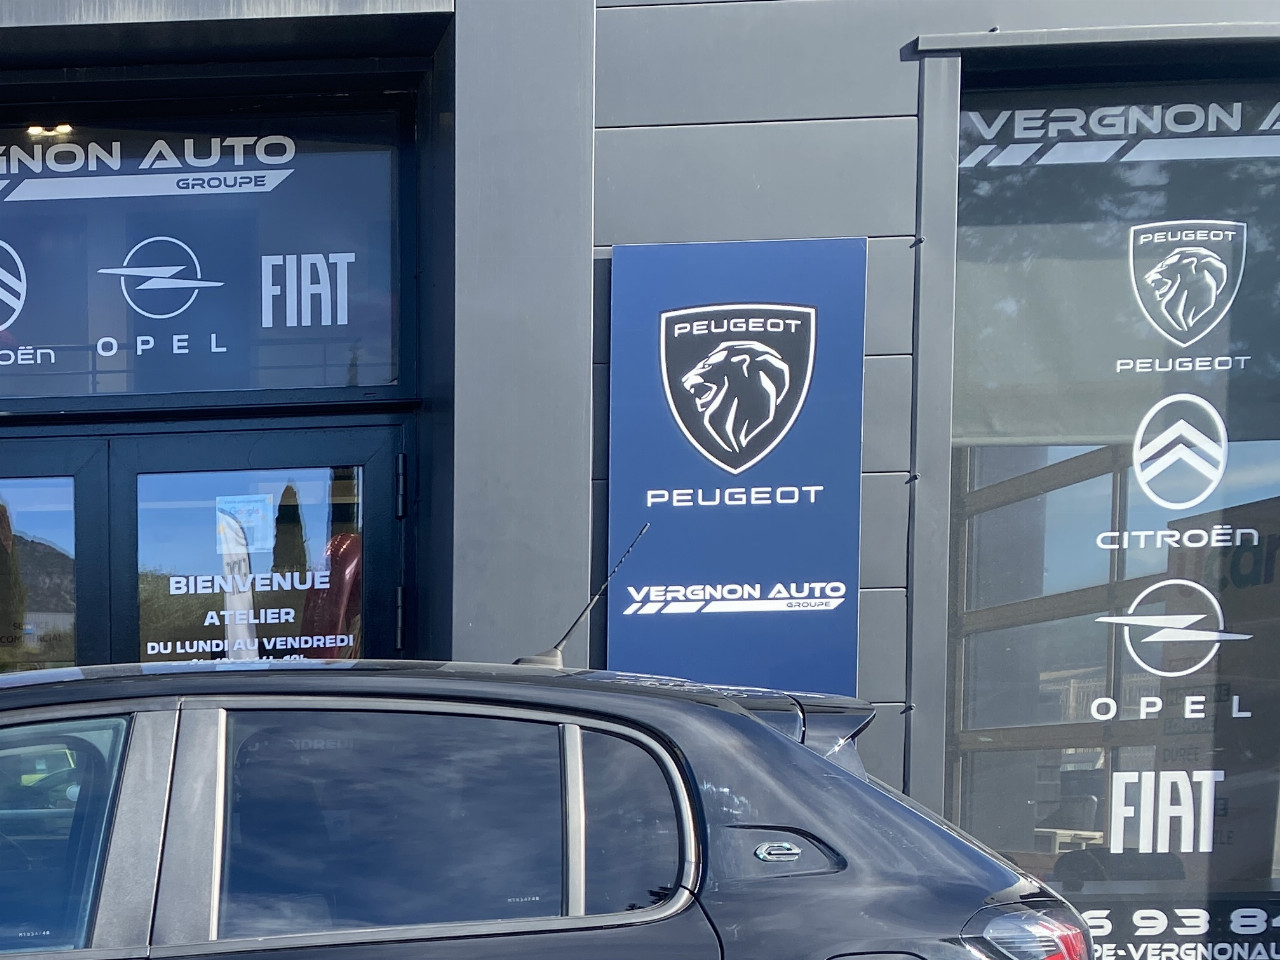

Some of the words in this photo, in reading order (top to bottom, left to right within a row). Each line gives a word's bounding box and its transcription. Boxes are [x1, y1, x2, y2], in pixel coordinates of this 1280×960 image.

[968, 102, 1242, 140] VERGNON
[137, 135, 297, 170] AUTO
[175, 174, 267, 191] GROUPE
[1139, 230, 1237, 244] PEUGEOT
[261, 252, 356, 328] FIAT
[673, 318, 802, 337] PEUGEOT
[96, 333, 228, 357] OPEL
[1116, 356, 1252, 373] PEUGEOT
[646, 485, 824, 507] PEUGEOT
[169, 571, 331, 595] BIENVENUE
[627, 583, 761, 601] VERGNON
[767, 581, 846, 599] AUTO
[786, 600, 831, 608] GROUPE
[12, 621, 50, 631] SECE
[204, 608, 296, 626] ATELIER
[0, 633, 62, 644] COMRCIAL
[146, 641, 172, 655] DU
[176, 639, 228, 654] LUNDI
[233, 638, 259, 650] AU
[262, 634, 354, 650] VENDREDI
[1091, 695, 1253, 721] OPEL
[1110, 770, 1225, 853] FIAT
[1132, 908, 1210, 936] 93
[1230, 907, 1280, 935] 8
